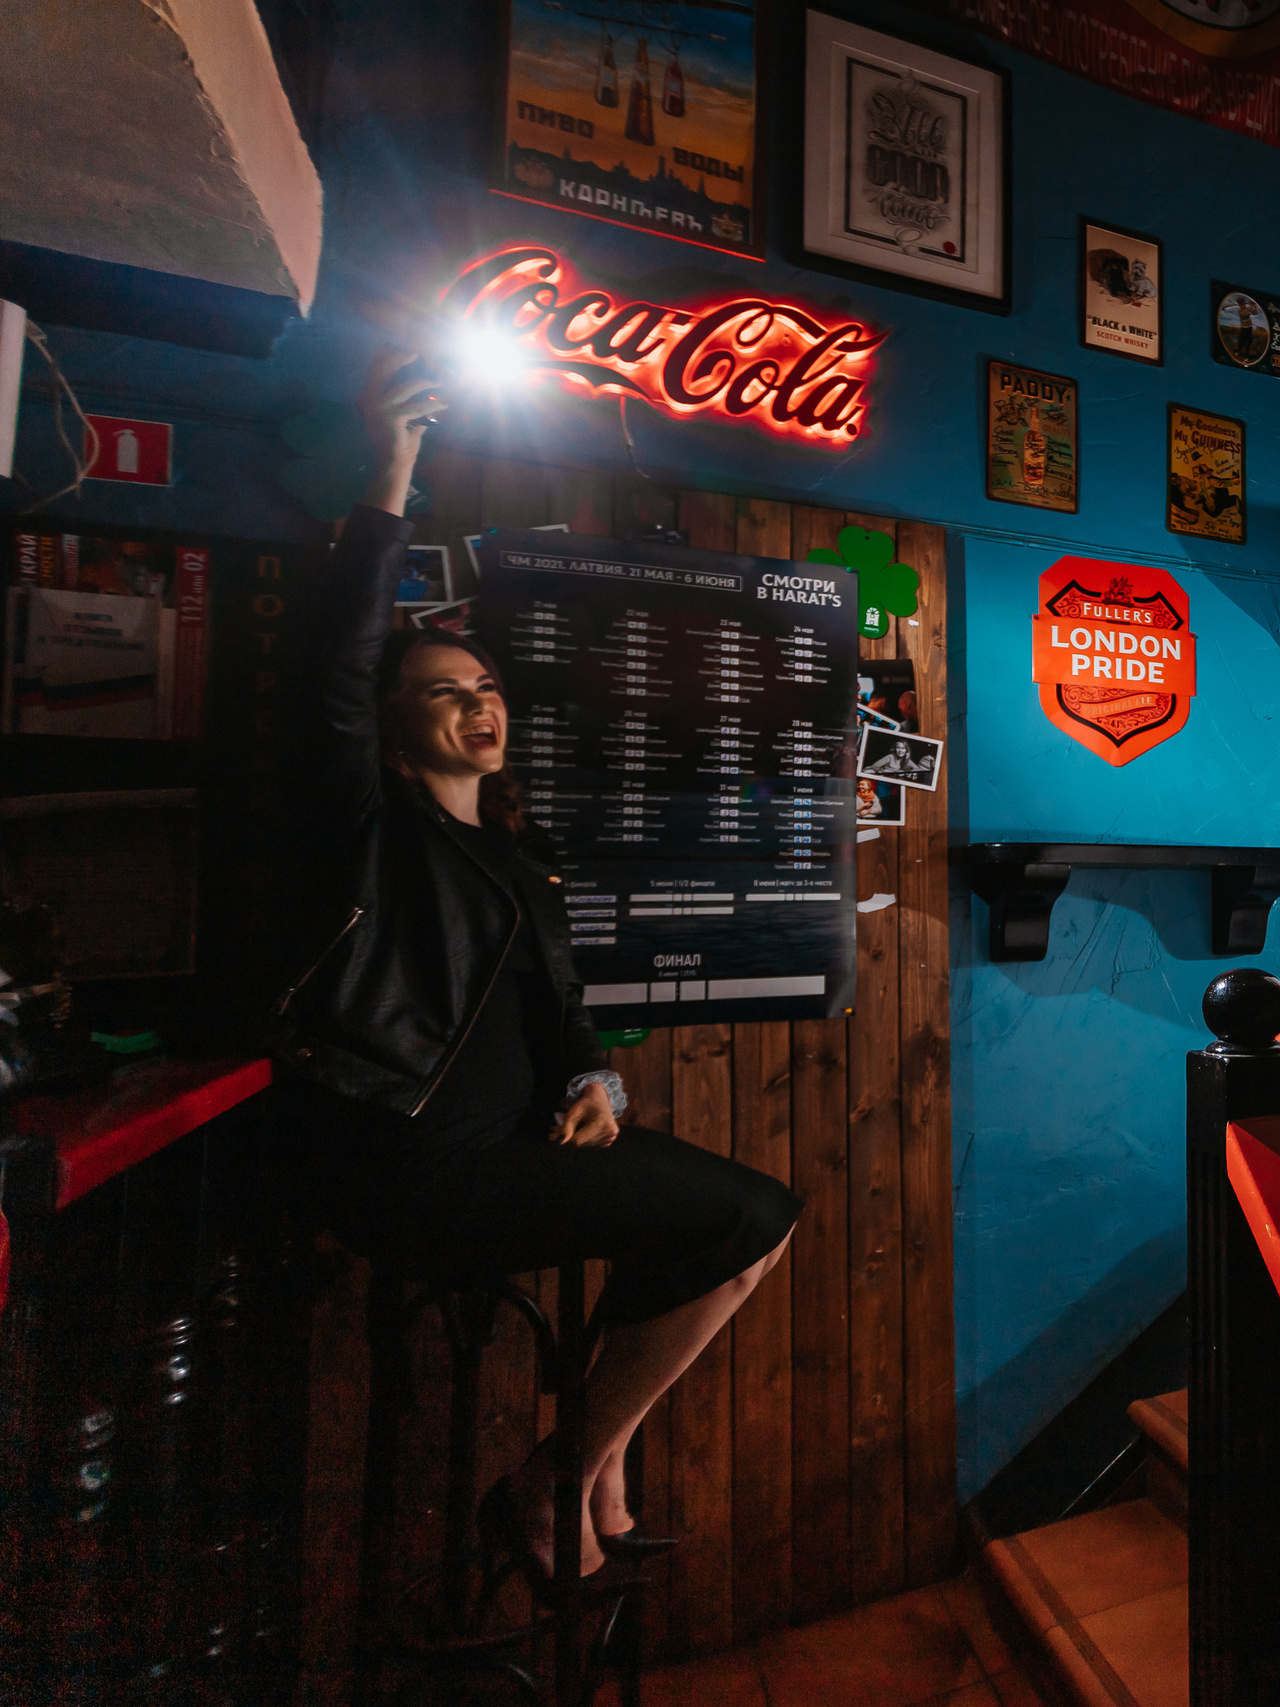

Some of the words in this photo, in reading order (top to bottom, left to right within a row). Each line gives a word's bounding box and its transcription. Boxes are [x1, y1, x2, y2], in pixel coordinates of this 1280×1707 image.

[517, 100, 594, 139] ПИВО
[672, 146, 744, 183] ВОДЫ
[448, 247, 891, 434] Coca-Cola
[1096, 331, 1122, 343] SCOTCH
[1124, 336, 1149, 349] WHISKY
[1001, 374, 1067, 406] PADDY
[1180, 415, 1193, 430] My
[1196, 419, 1236, 437] Goodness
[1174, 429, 1188, 445] My
[1191, 430, 1241, 454] GUINNESS
[20, 533, 38, 574] КРАЙ
[184, 553, 206, 571] 02
[507, 554, 531, 567] ЧМ
[629, 566, 641, 577] 21
[644, 569, 674, 581] МАЯ
[684, 573, 692, 583] 6
[695, 576, 736, 588] ИЮНЯ
[761, 573, 836, 594] СМОТРИ
[181, 596, 203, 622] 112
[756, 587, 767, 599] В
[772, 587, 842, 608] HARAT'S
[1083, 602, 1151, 623] FULLER'S
[1051, 626, 1181, 660] LONDON
[1072, 654, 1164, 684] PRIDE
[1084, 699, 1133, 715] ORIGINAL
[1134, 696, 1152, 706] ALE
[792, 719, 800, 727] 28
[653, 953, 702, 969] ФИНАЛ
